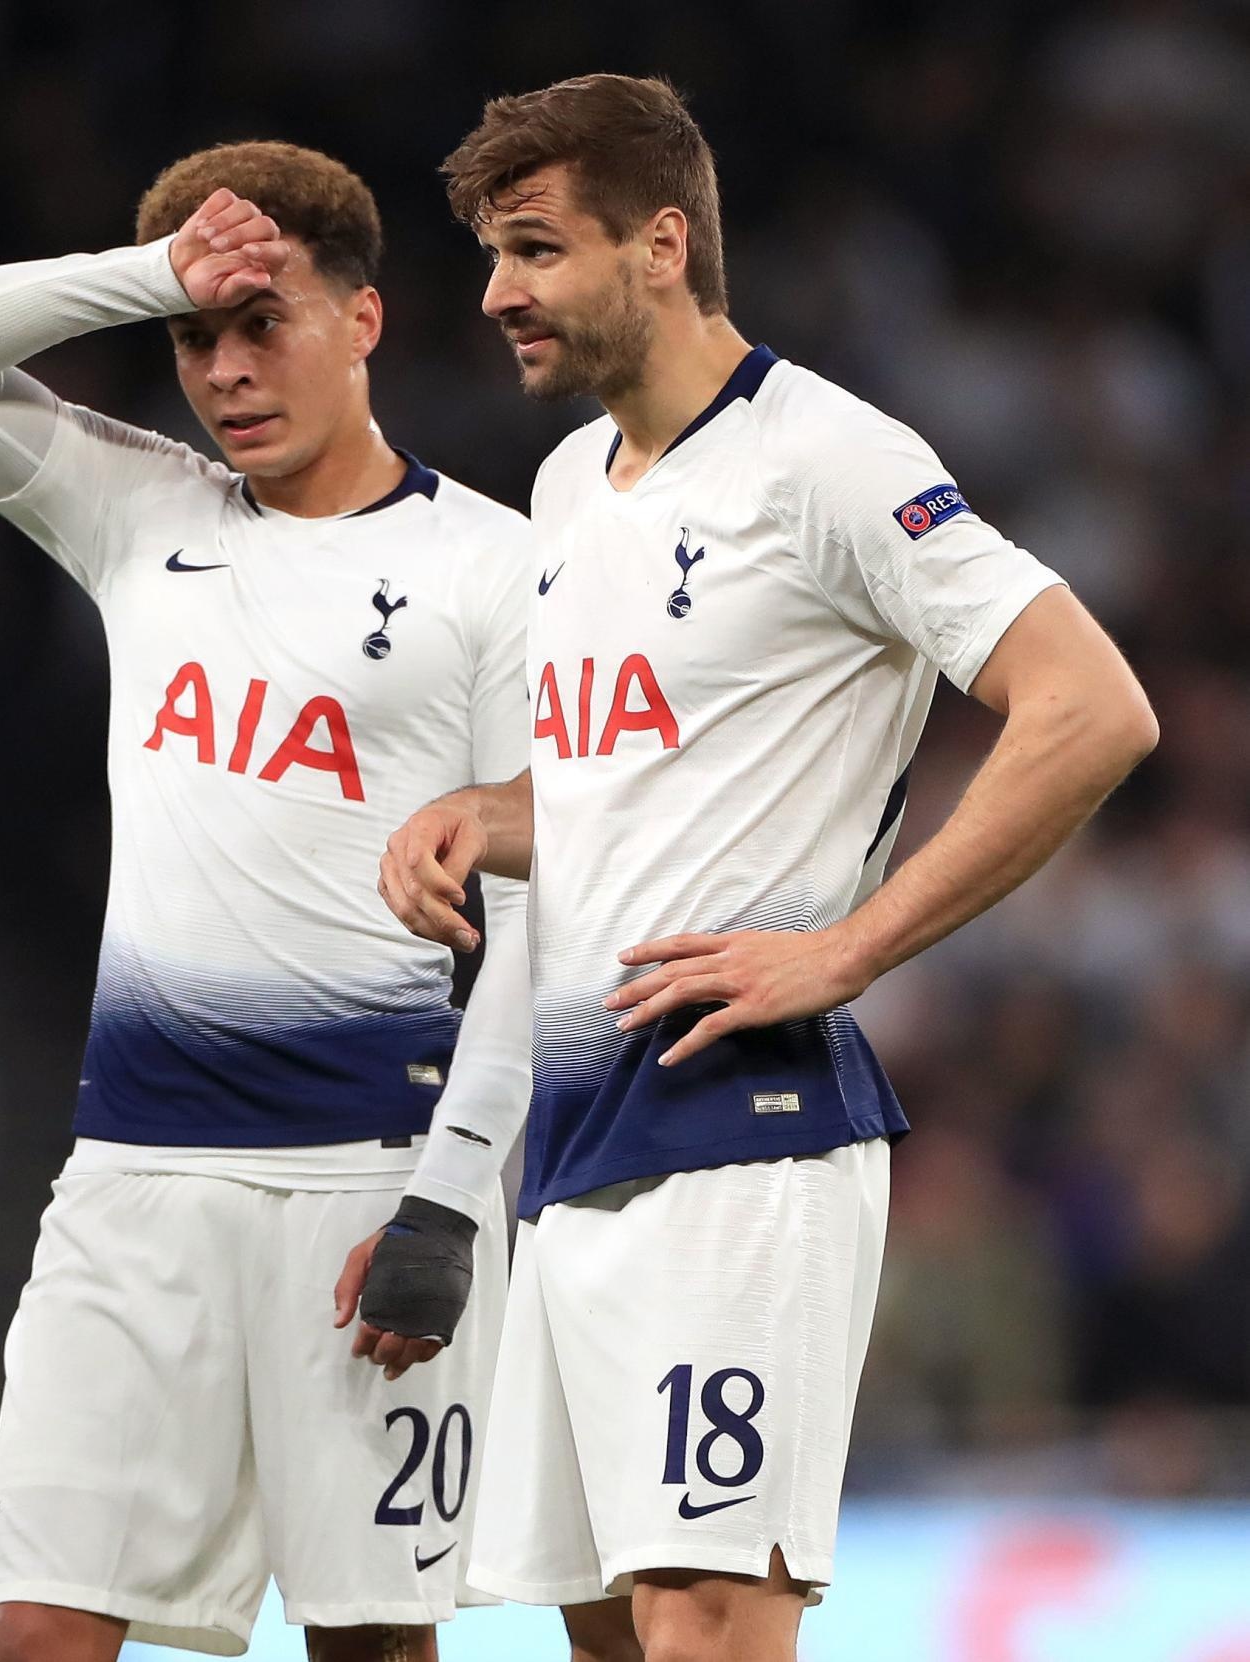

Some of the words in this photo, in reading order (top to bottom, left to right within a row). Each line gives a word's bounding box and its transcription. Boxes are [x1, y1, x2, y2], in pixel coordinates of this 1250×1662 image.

[144, 661, 365, 802] AIA
[535, 654, 680, 759] AIA
[374, 1403, 473, 1526] 20
[657, 1364, 765, 1488] 18
